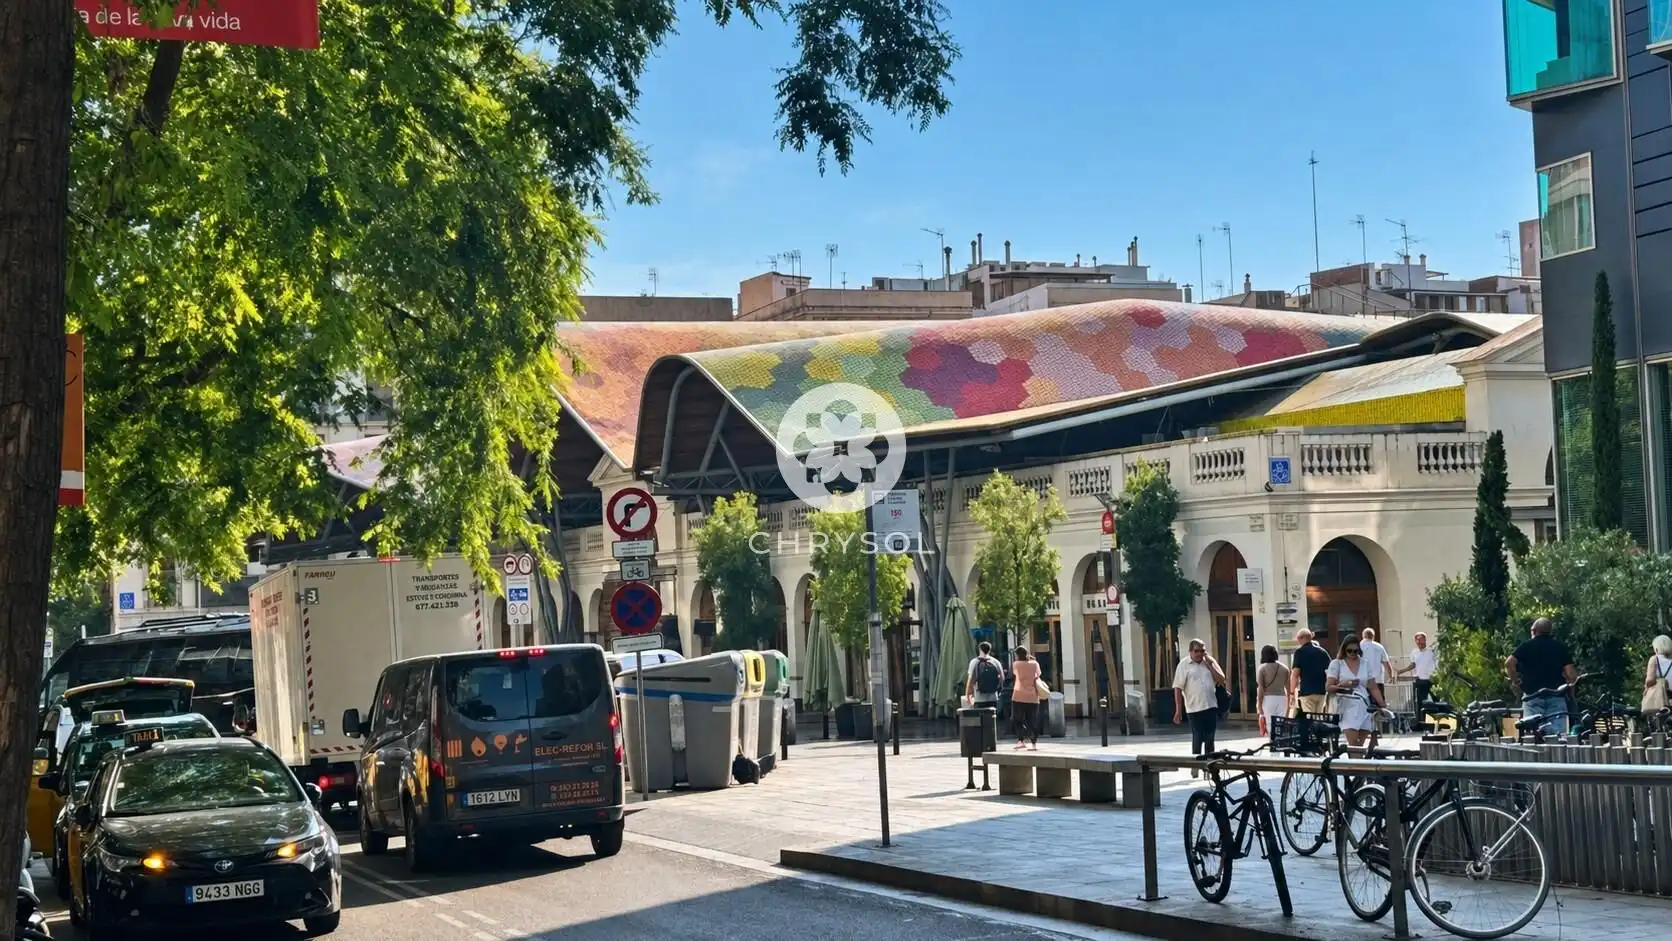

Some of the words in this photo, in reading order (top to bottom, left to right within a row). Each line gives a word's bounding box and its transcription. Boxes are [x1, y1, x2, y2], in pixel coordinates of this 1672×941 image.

[95, 7, 122, 25] de
[127, 6, 142, 26] la
[199, 11, 241, 31] vida
[471, 791, 496, 804] 1612
[499, 789, 518, 802] LYN
[195, 884, 230, 900] 9433
[234, 881, 261, 897] NGG
